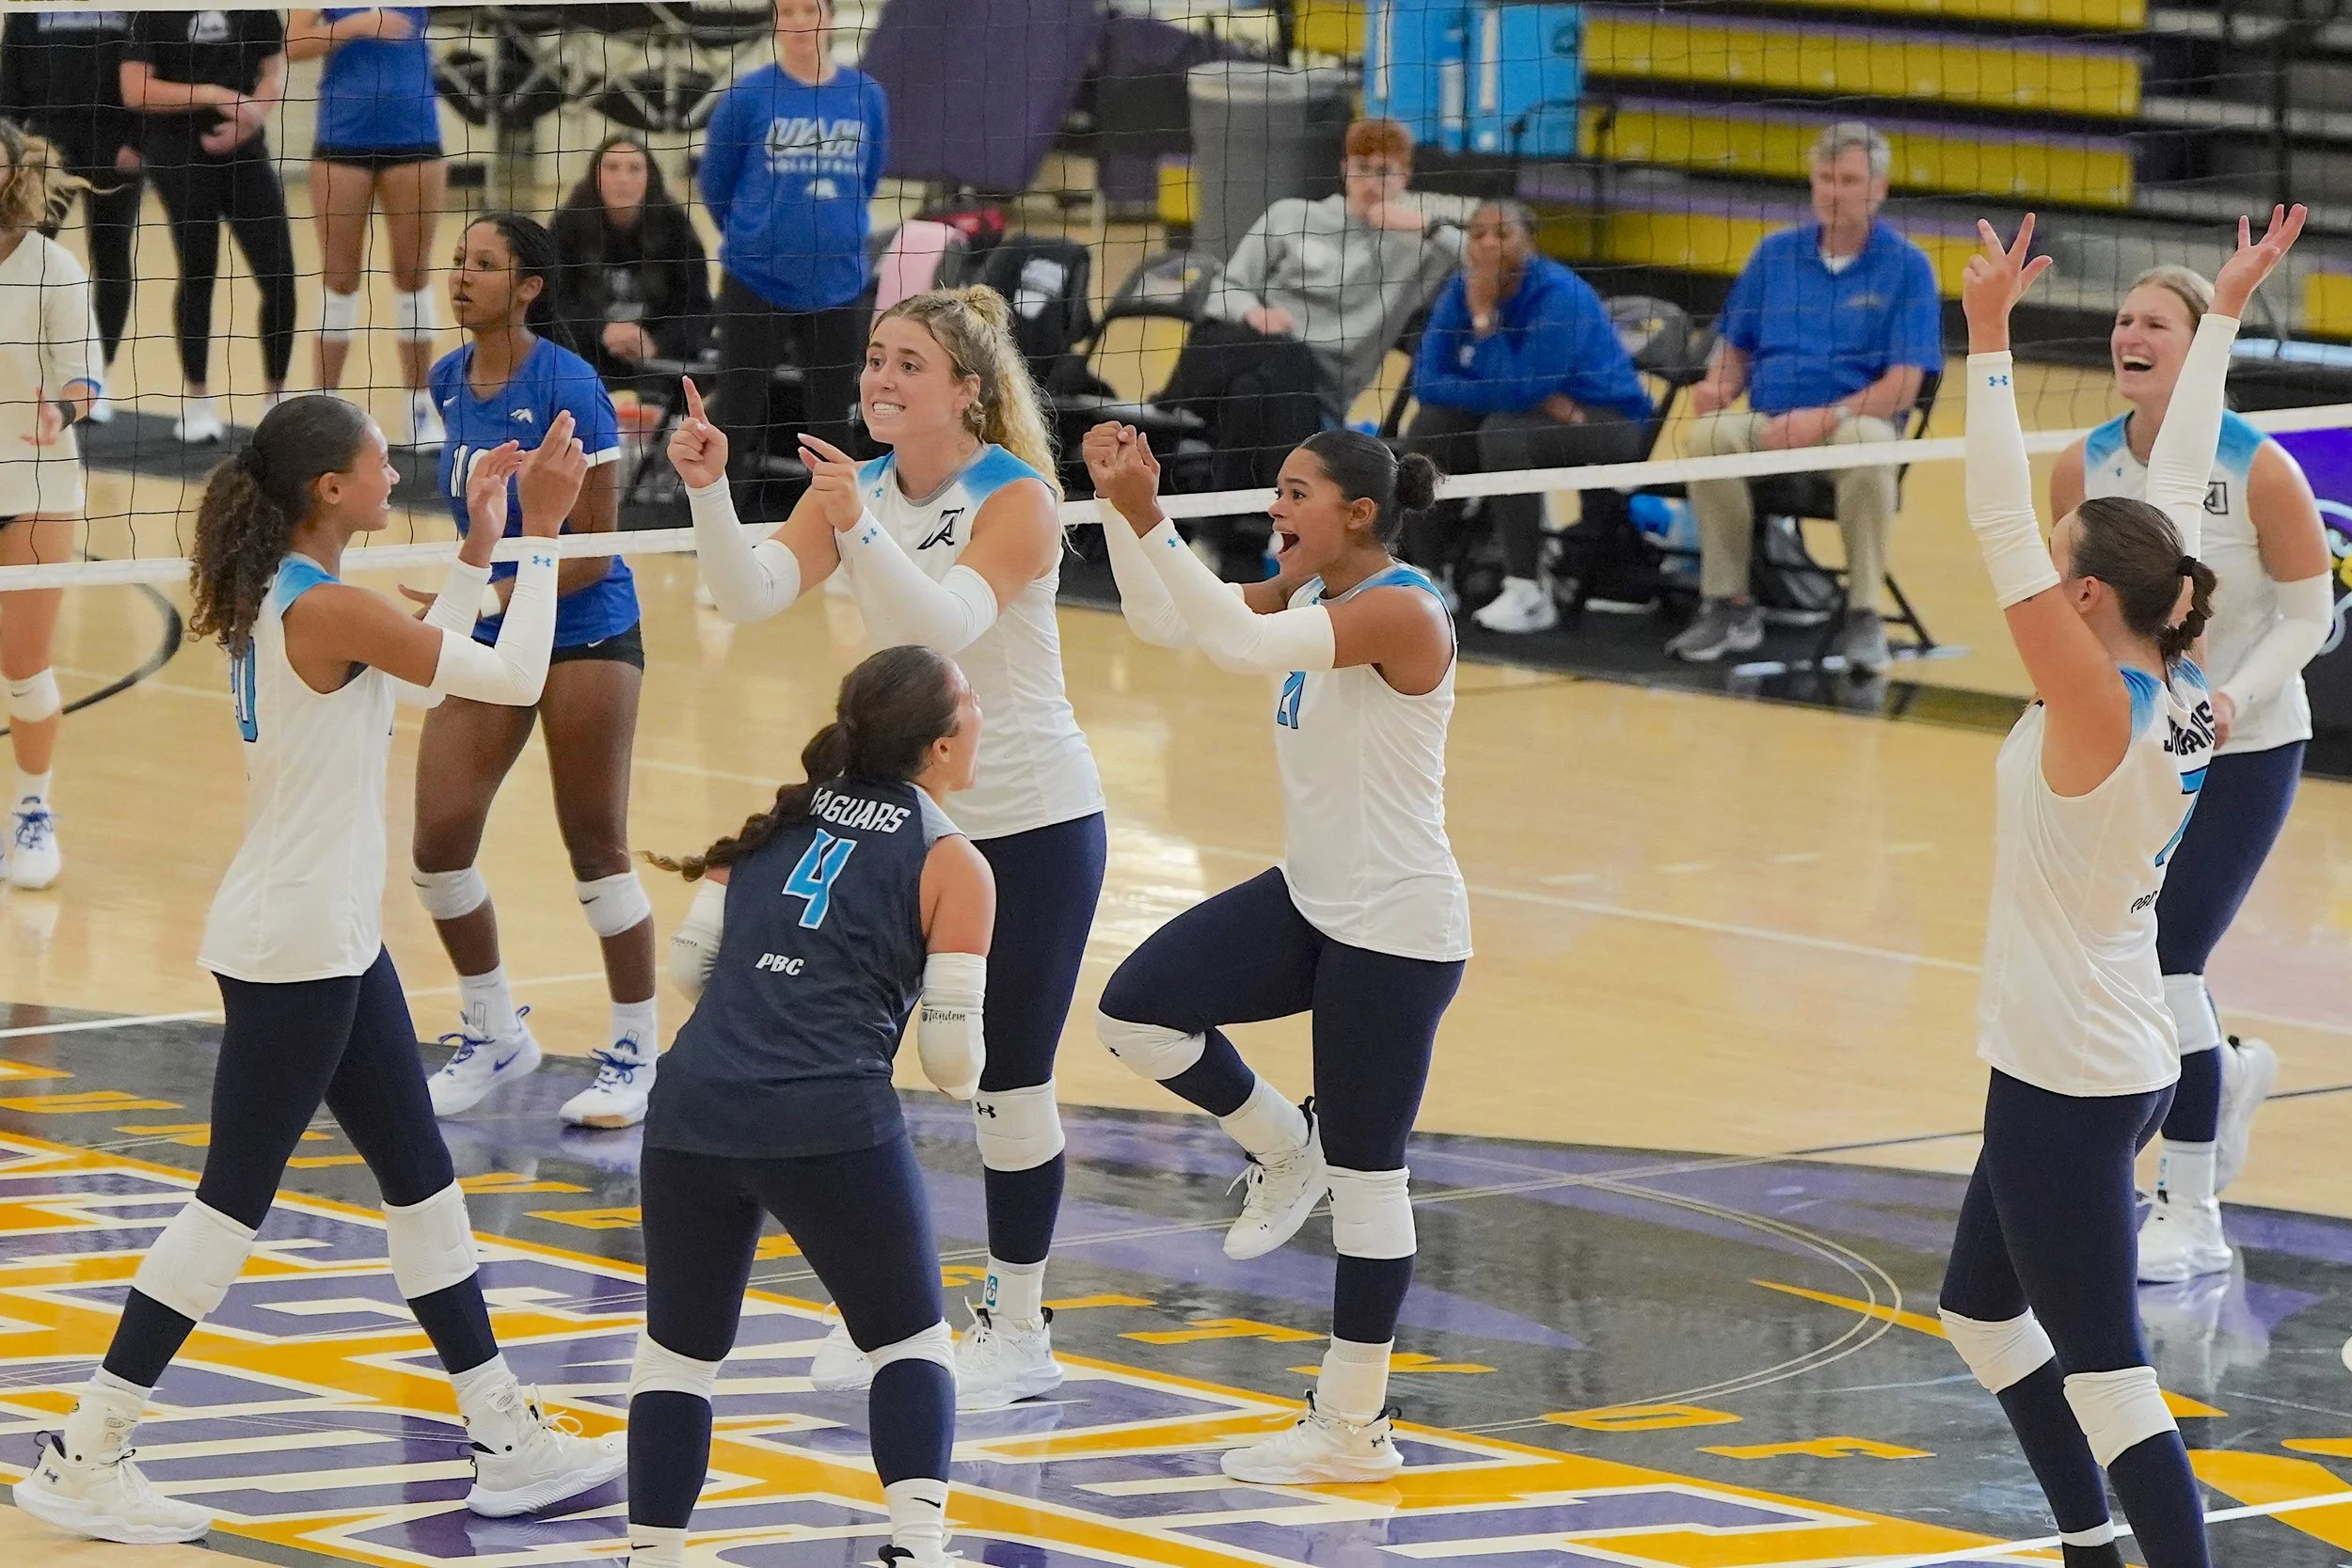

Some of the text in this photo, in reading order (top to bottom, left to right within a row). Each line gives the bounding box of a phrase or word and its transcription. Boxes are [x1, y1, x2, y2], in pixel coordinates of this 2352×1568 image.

[781, 828, 858, 930] 4
[755, 952, 805, 976] PBC
[1543, 1402, 1936, 1460] OF
